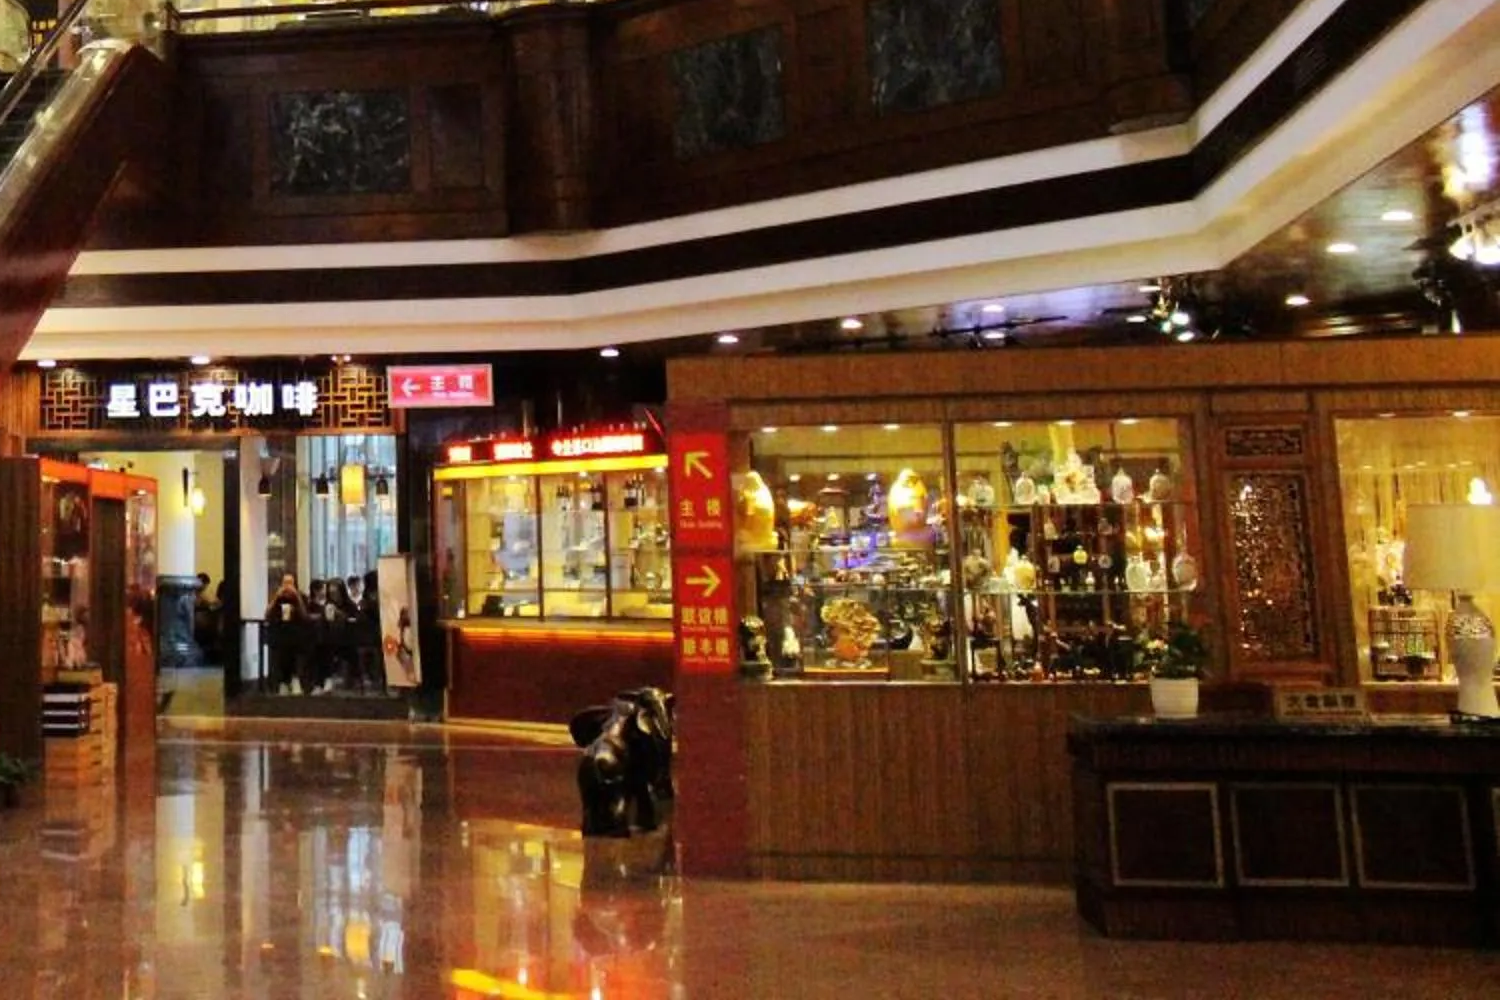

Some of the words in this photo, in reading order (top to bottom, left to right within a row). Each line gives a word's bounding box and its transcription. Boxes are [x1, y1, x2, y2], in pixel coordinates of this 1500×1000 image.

[106, 381, 319, 418] 星巴克咖啡
